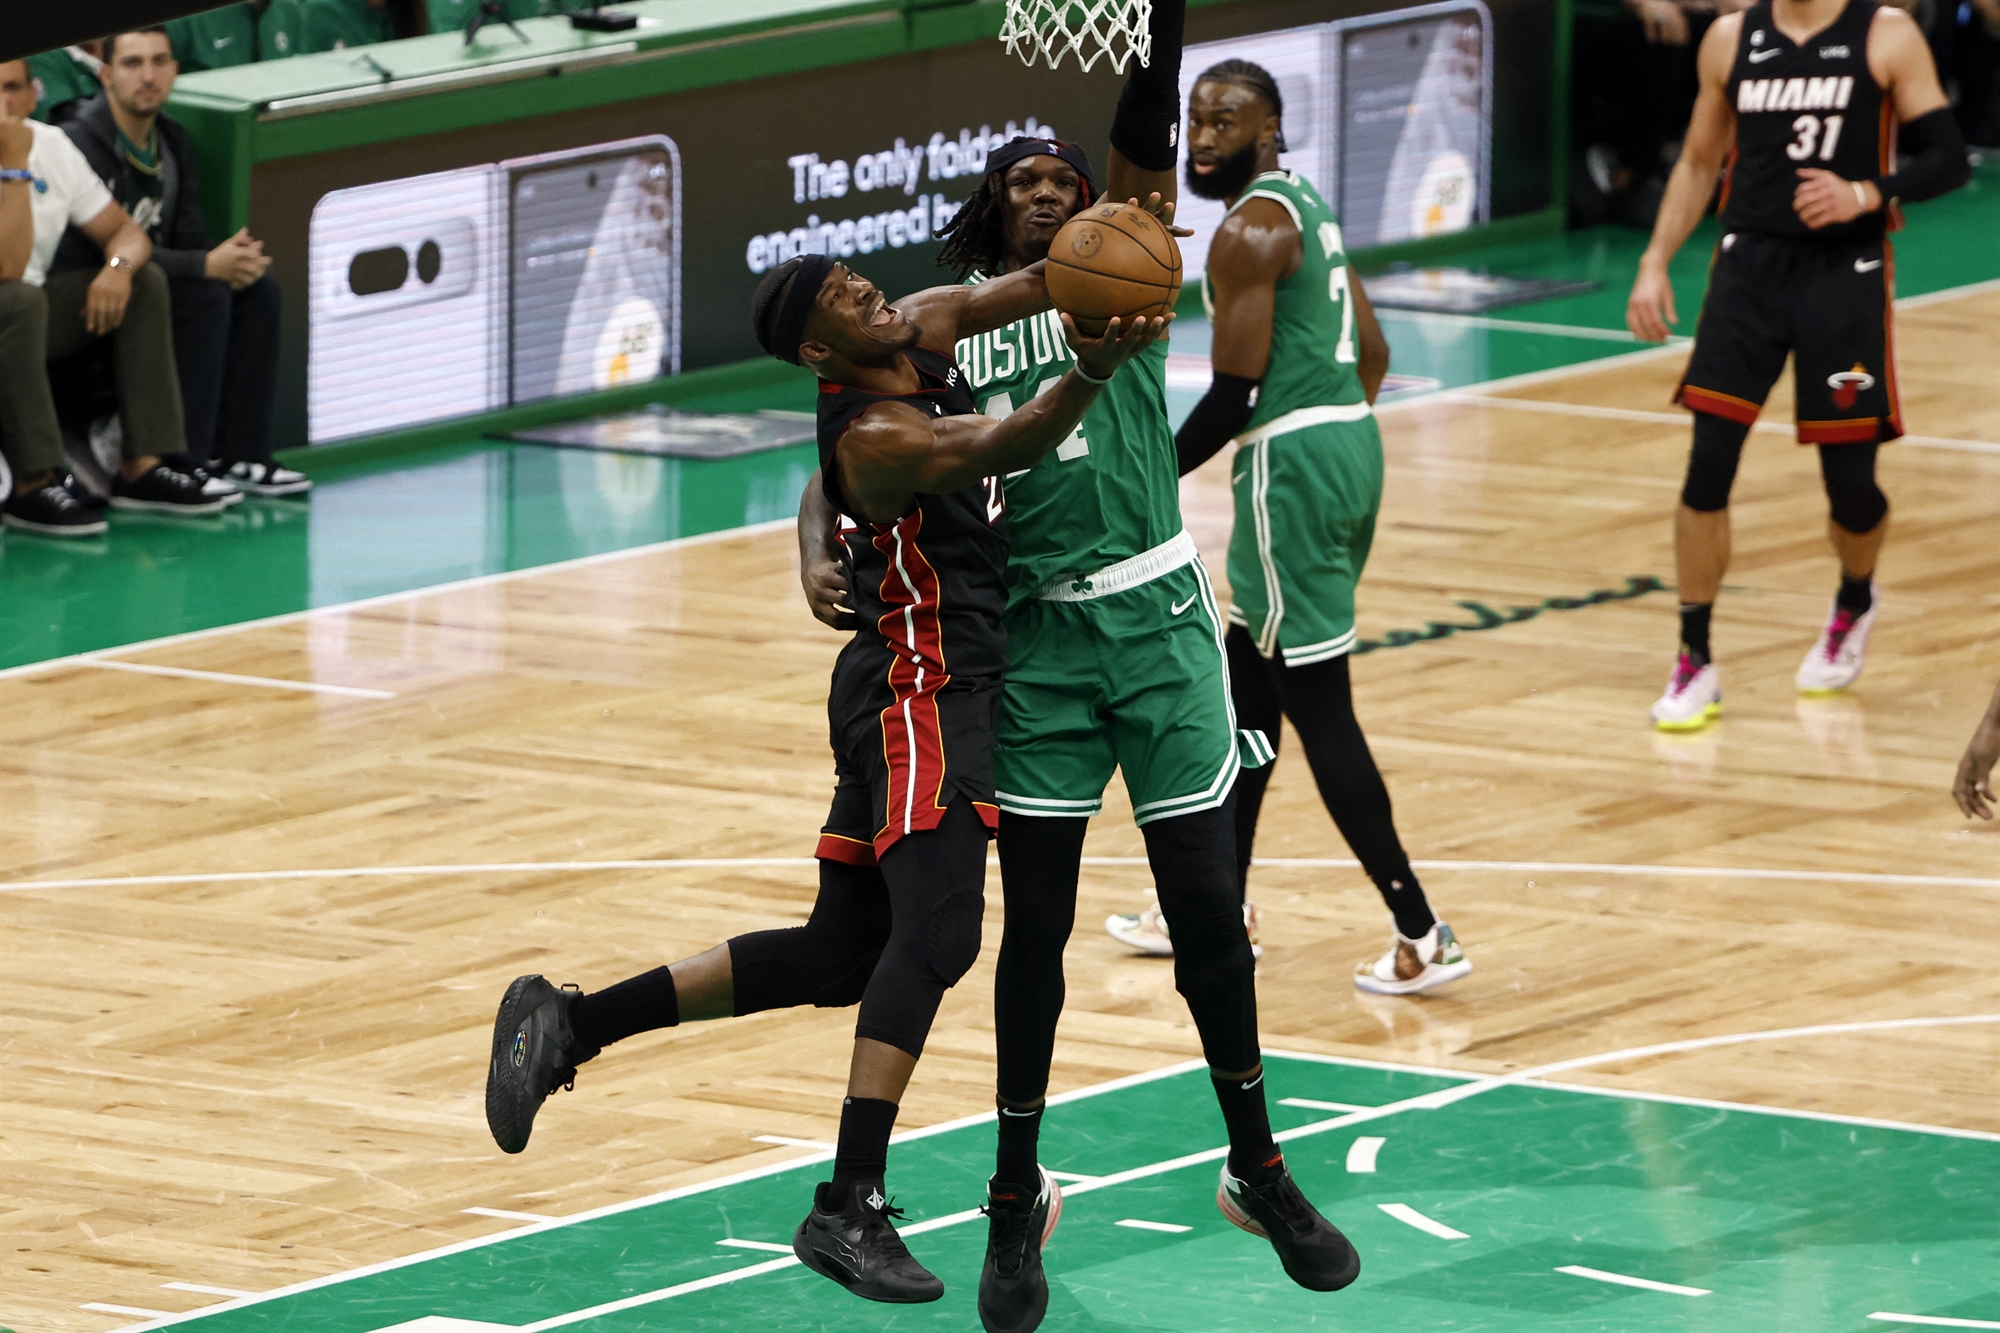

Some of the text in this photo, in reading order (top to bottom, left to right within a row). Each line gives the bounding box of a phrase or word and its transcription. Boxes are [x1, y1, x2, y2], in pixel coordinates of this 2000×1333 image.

[1737, 76, 1854, 113] MIAMI
[1786, 114, 1844, 161] 31
[788, 153, 849, 203] The
[854, 137, 922, 196] only
[955, 307, 1079, 390] BOSTON
